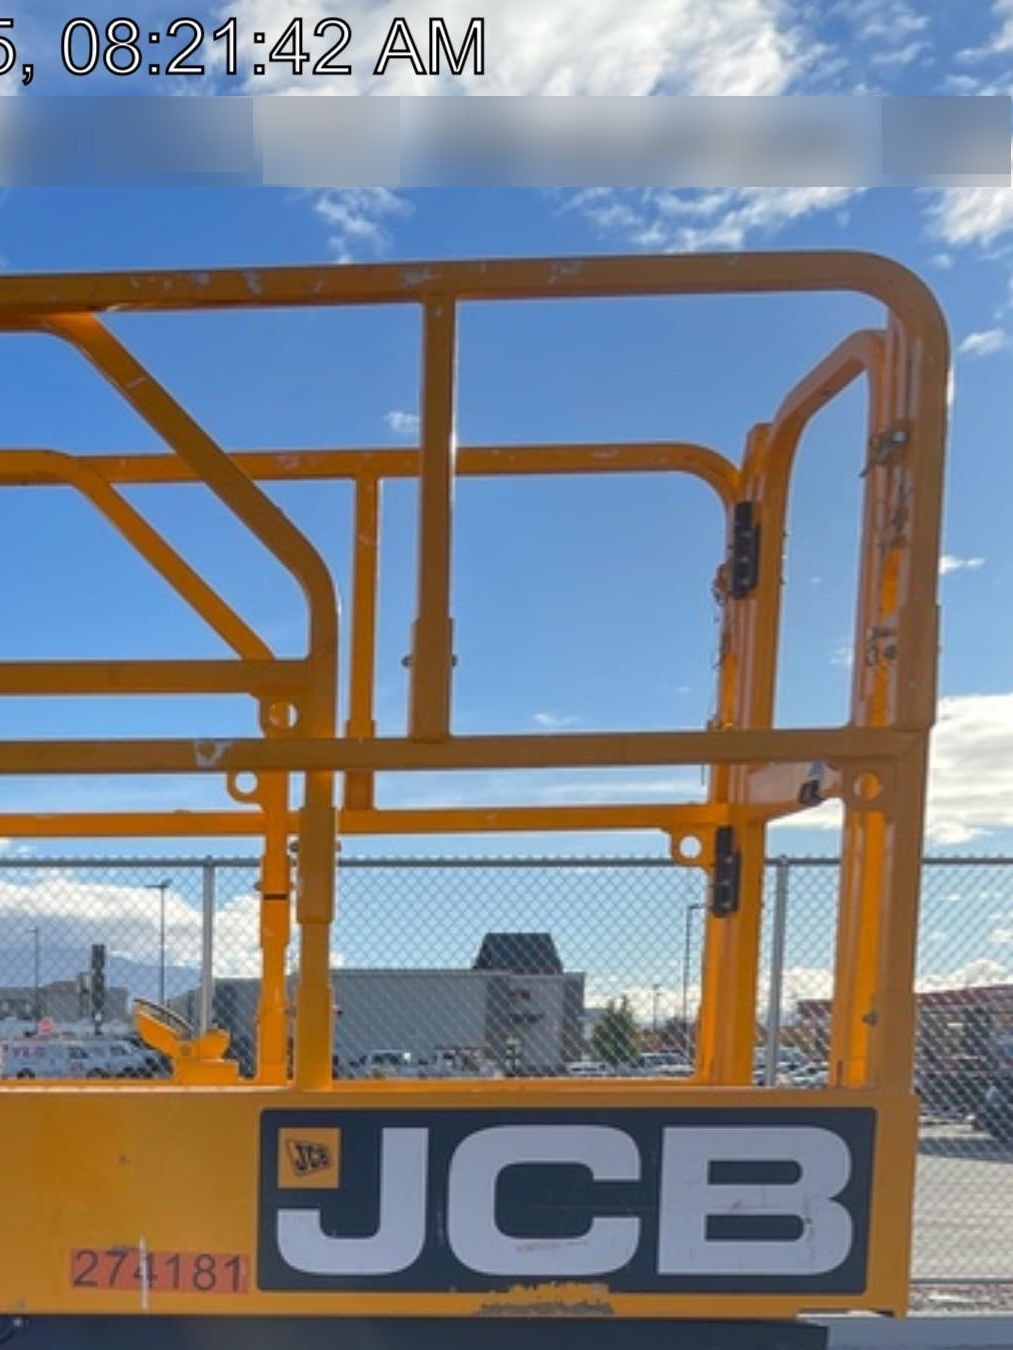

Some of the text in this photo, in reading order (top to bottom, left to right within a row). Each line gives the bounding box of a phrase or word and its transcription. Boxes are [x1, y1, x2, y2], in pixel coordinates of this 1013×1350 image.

[293, 1142, 331, 1172] JCB
[276, 1124, 853, 1276] JCB
[72, 1248, 242, 1293] 274181
